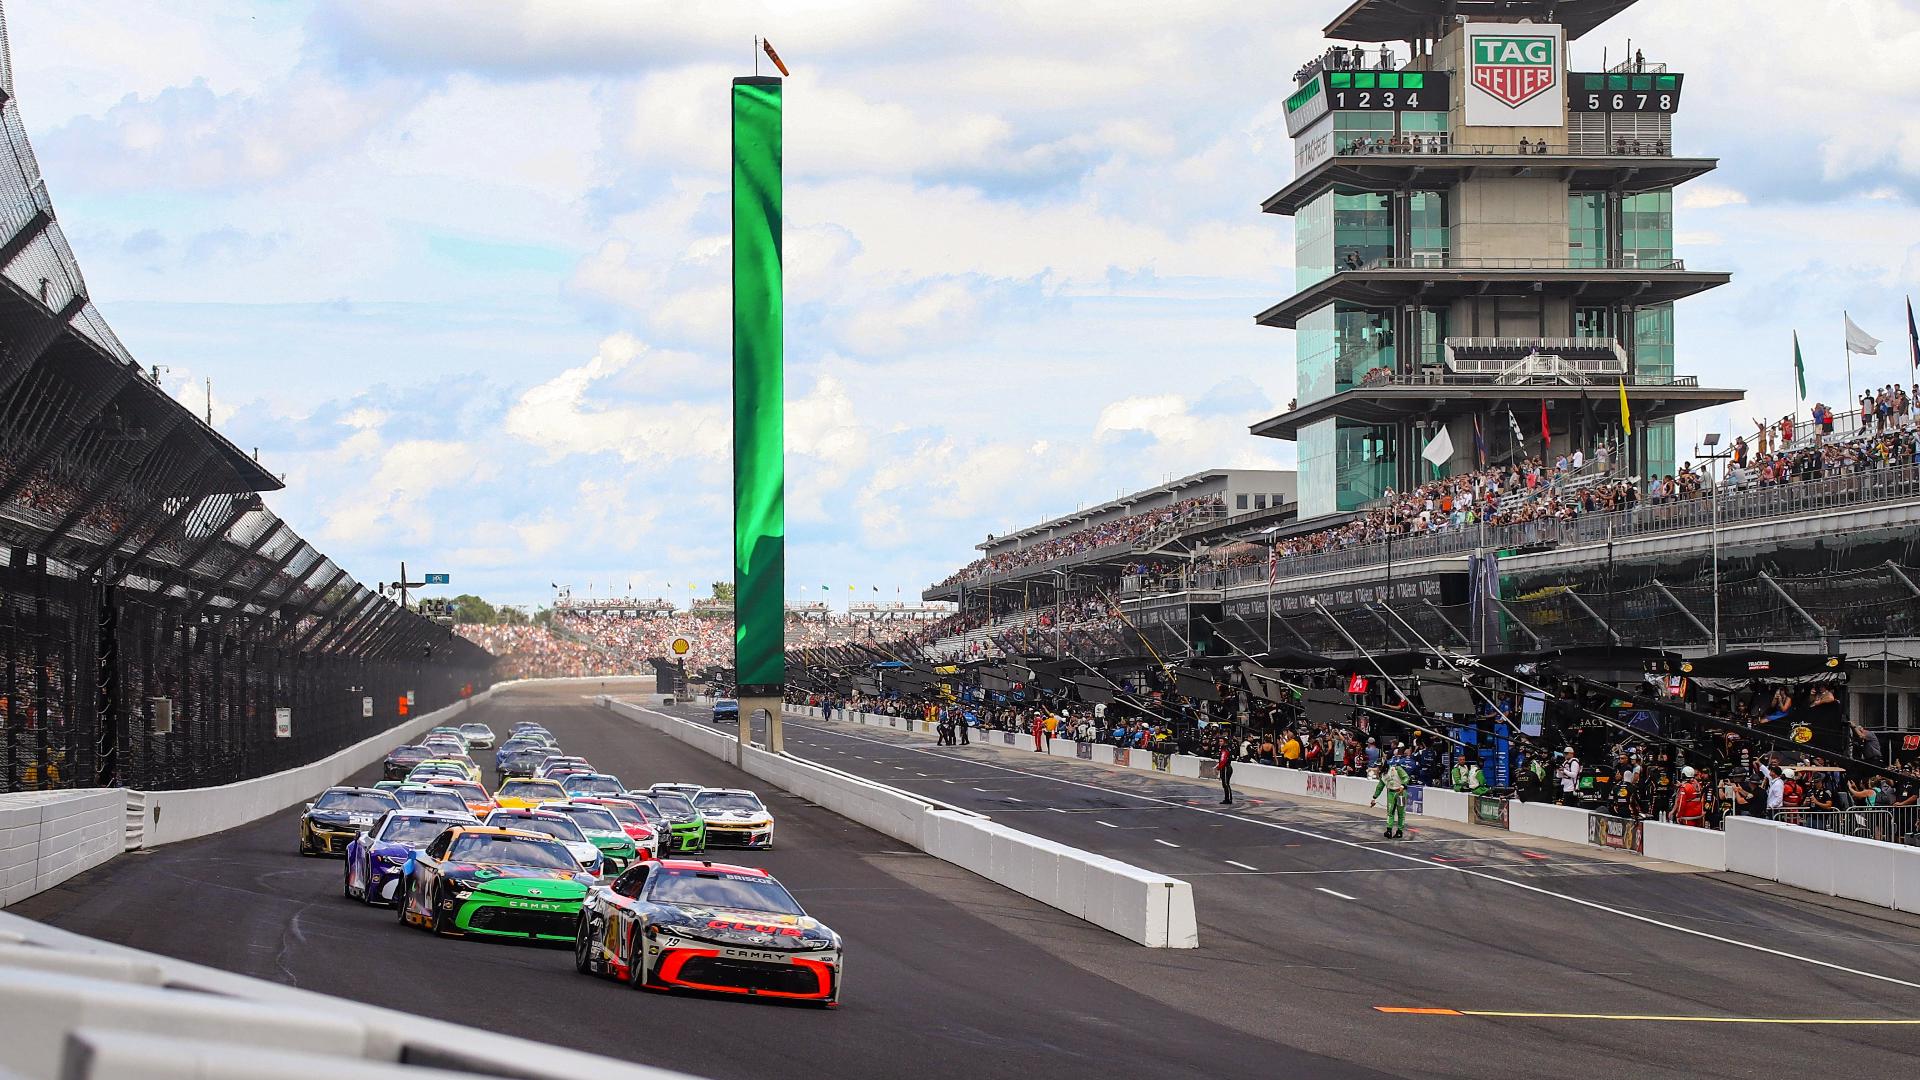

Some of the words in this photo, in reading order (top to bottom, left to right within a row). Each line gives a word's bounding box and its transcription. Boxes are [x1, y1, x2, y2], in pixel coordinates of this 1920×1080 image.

[1479, 41, 1546, 62] TAG
[1477, 68, 1549, 101] HEUER
[1336, 92, 1345, 108] 1
[1359, 92, 1371, 108] 2
[1383, 92, 1394, 108] 3
[1406, 92, 1419, 108] 4
[1588, 94, 1600, 110] 5
[1612, 94, 1624, 110] 6
[1636, 94, 1648, 110] 7
[1659, 94, 1671, 110] 8
[726, 874, 774, 885] BRISCOE
[664, 937, 681, 947] 19
[725, 949, 787, 960] CAMRY
